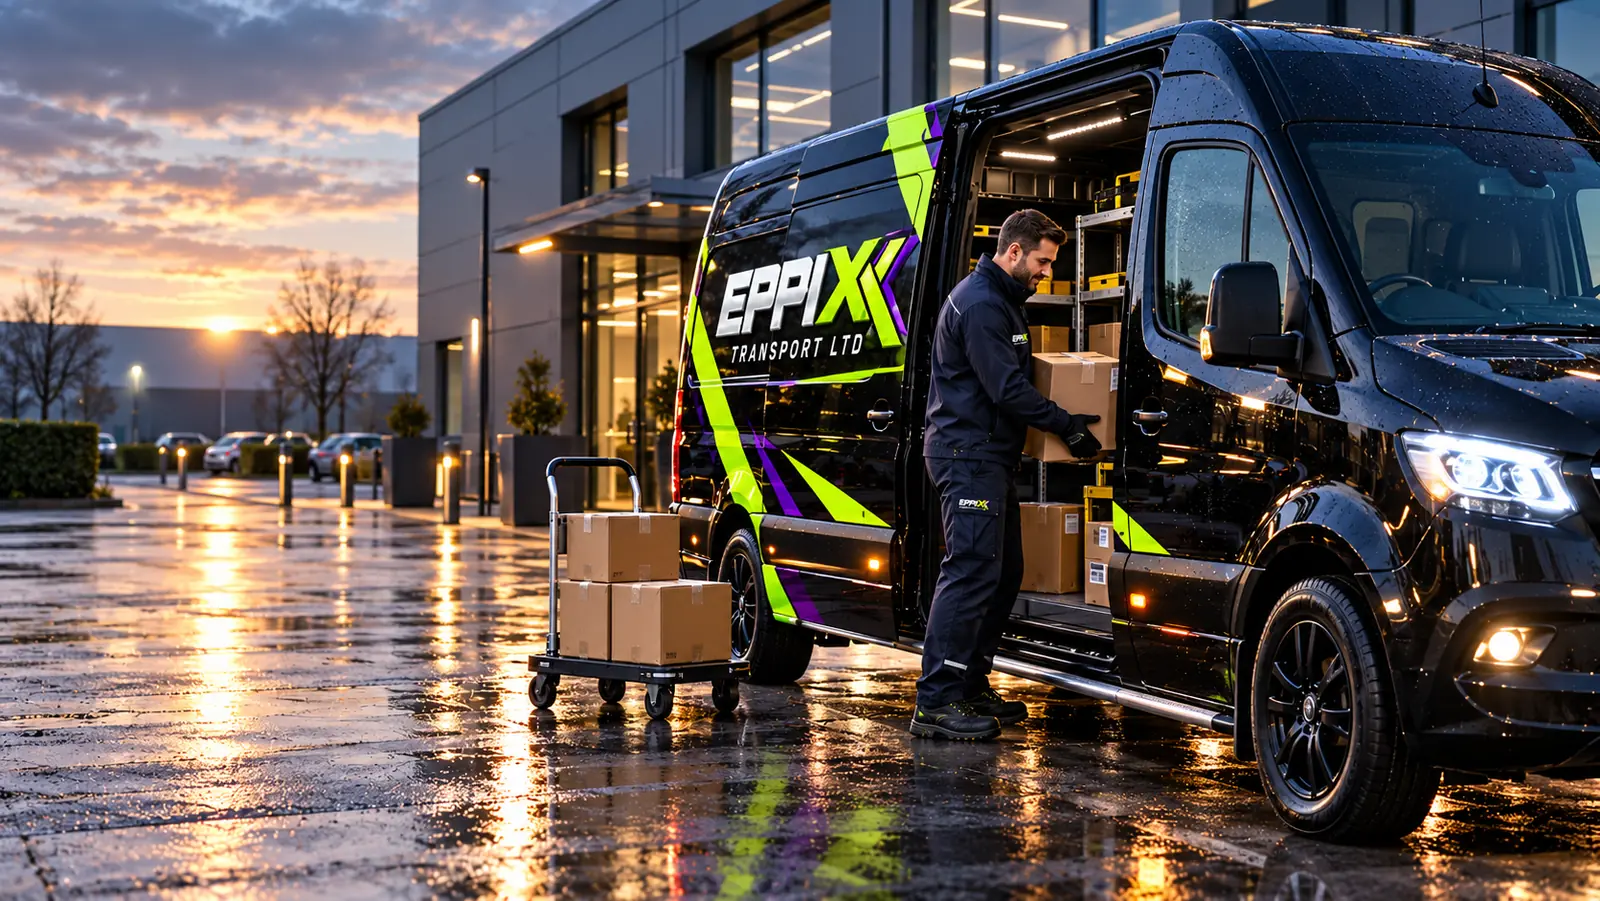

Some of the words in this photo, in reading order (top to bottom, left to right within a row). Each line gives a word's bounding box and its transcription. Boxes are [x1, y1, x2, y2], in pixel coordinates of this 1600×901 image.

[716, 237, 884, 337] EPPIX
[731, 337, 823, 363] TRANSPORT
[830, 333, 863, 357] LTD
